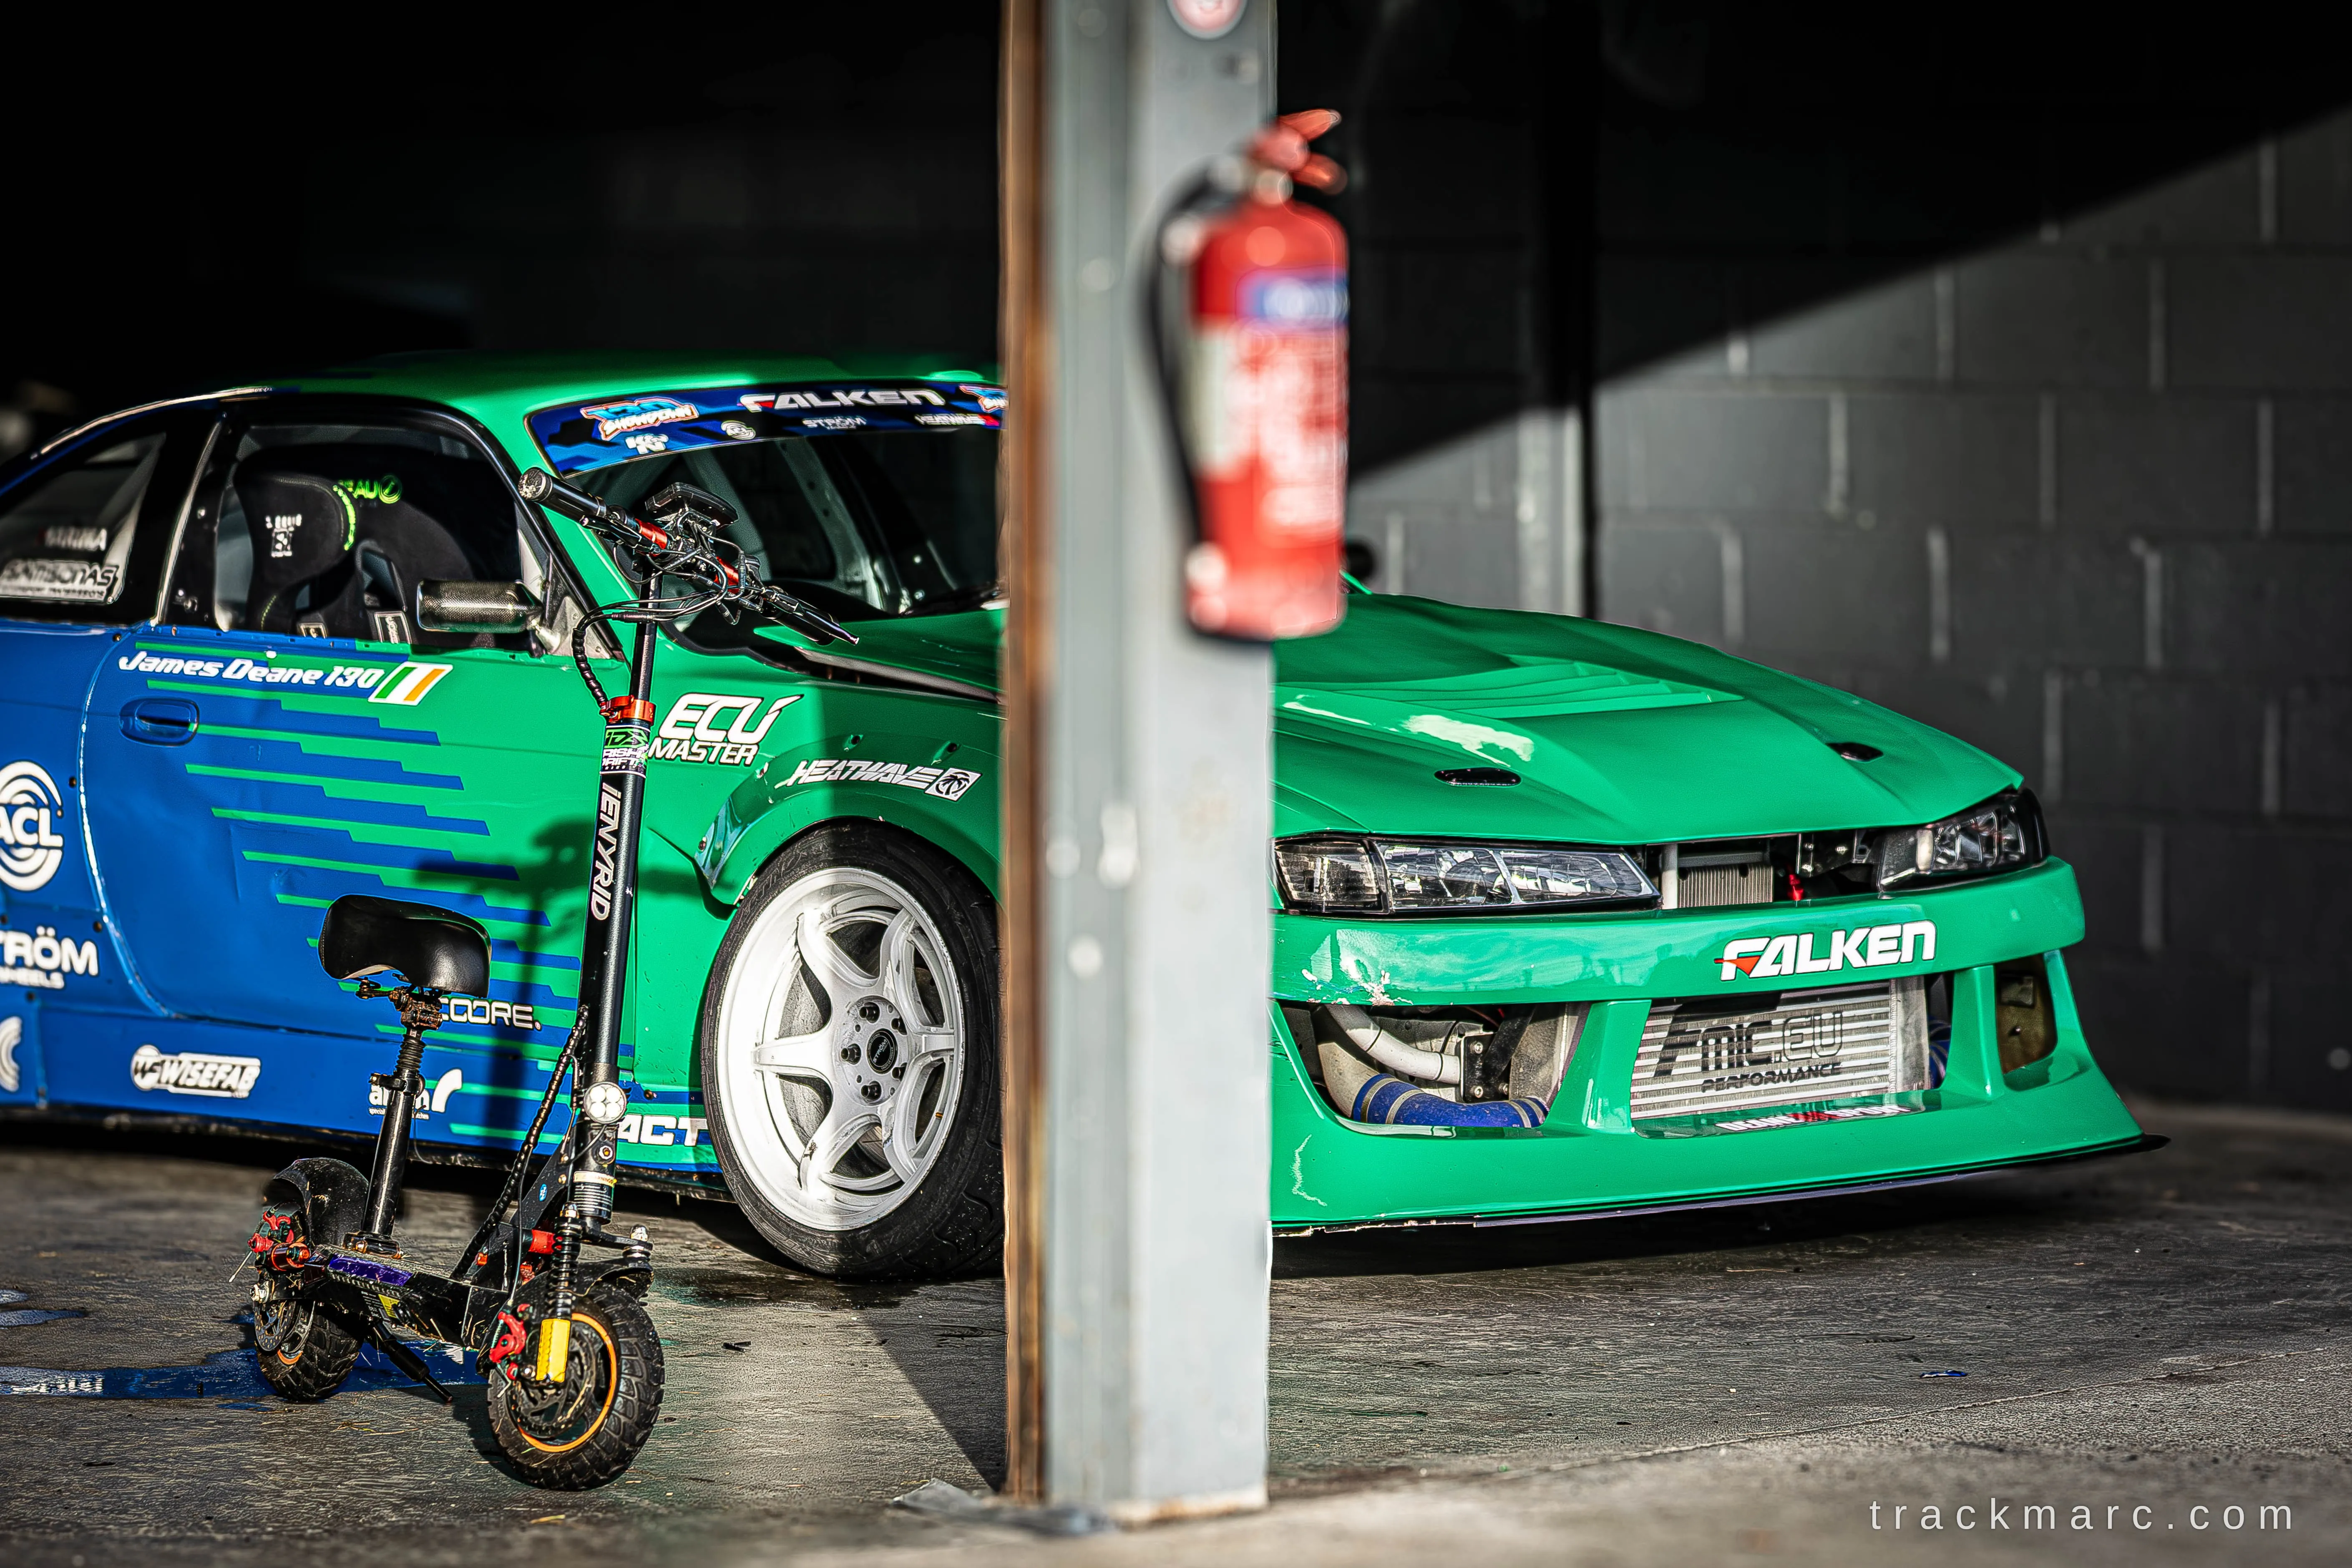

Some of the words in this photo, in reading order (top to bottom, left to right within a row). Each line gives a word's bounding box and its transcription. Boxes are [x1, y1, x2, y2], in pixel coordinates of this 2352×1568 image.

[737, 388, 946, 413] FALKEN
[119, 651, 224, 677] James
[221, 658, 324, 685] Deane
[323, 666, 385, 689] 130
[658, 692, 804, 744] ECU
[647, 737, 759, 765] MASTER
[786, 759, 945, 788] HEATWAVE
[0, 925, 98, 976] RÖM
[1714, 919, 1937, 982] FALKEN
[160, 1060, 260, 1091] WISEFAB
[1701, 1062, 1842, 1093] PERFORMANCE
